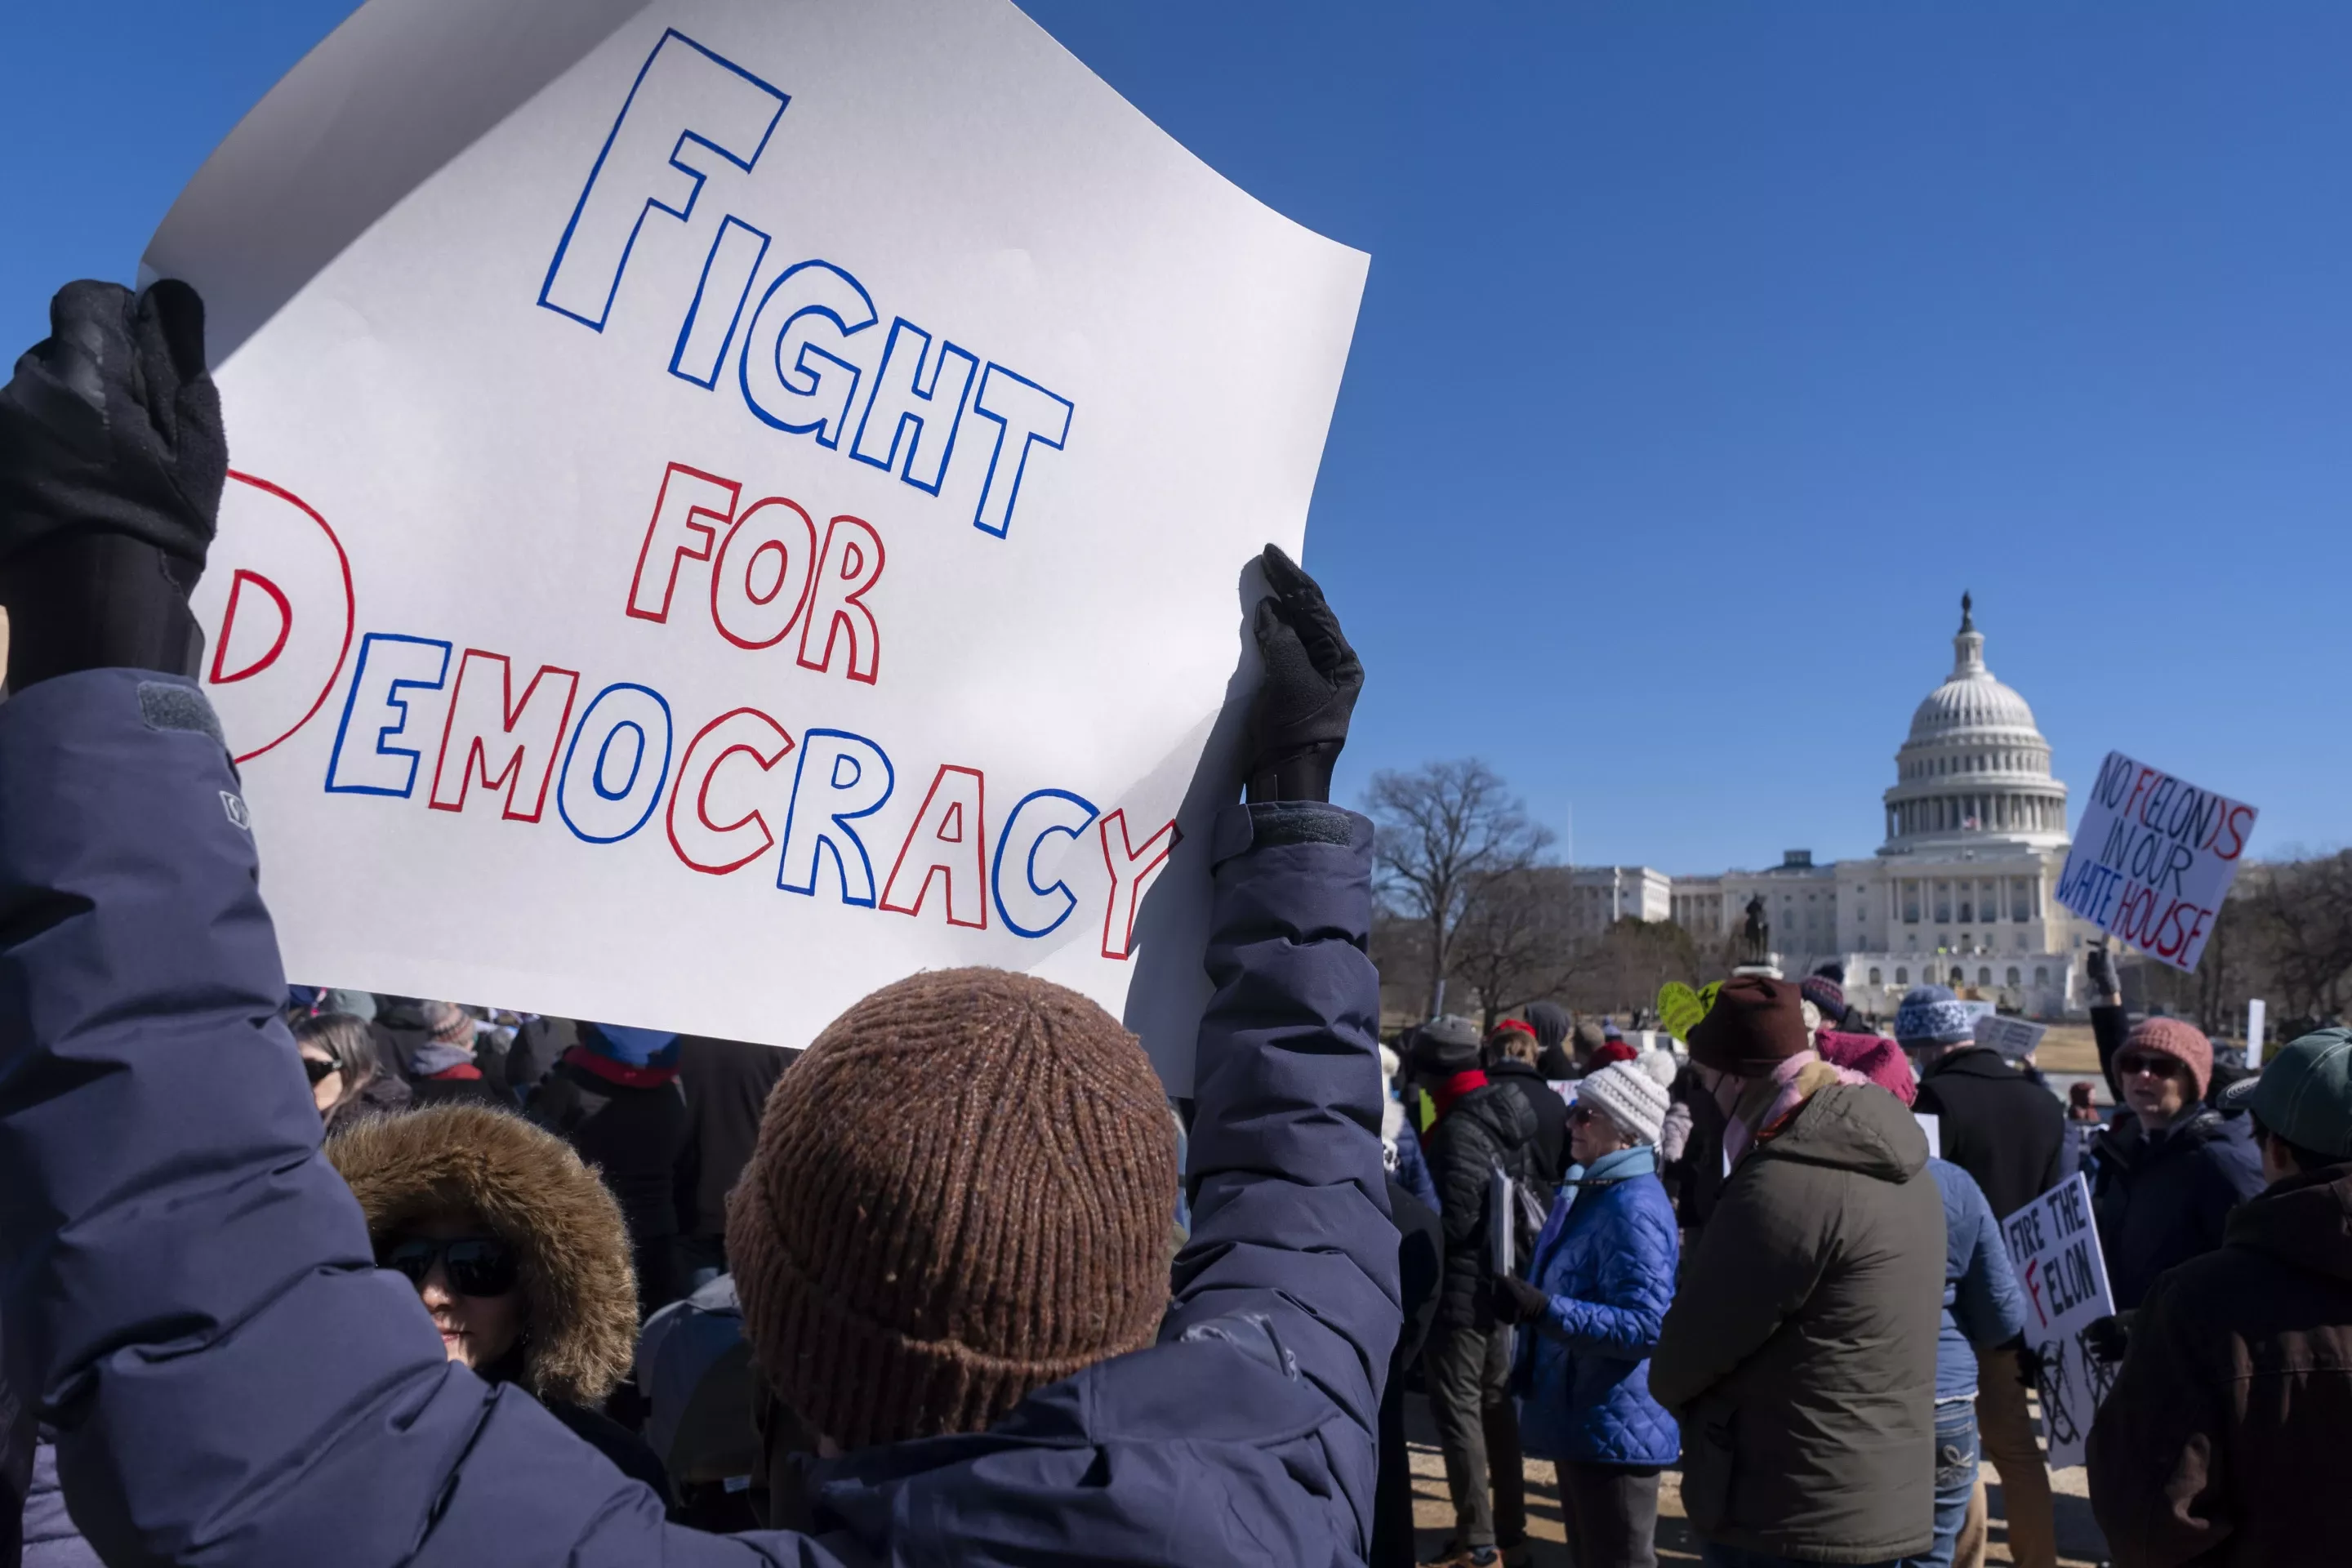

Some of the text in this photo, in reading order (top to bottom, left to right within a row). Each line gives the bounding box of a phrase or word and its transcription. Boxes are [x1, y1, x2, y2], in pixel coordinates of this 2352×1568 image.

[537, 28, 1076, 540] FIGHT
[626, 461, 886, 686] FOR
[209, 468, 1184, 961] DEMOCRACY
[2090, 752, 2255, 862] NO F(ELON)S
[2100, 817, 2194, 898] IN OUR
[2057, 849, 2213, 968] WHITE HOUSE
[2009, 1180, 2087, 1265] FIRE THE
[2025, 1238, 2097, 1330] FELON
